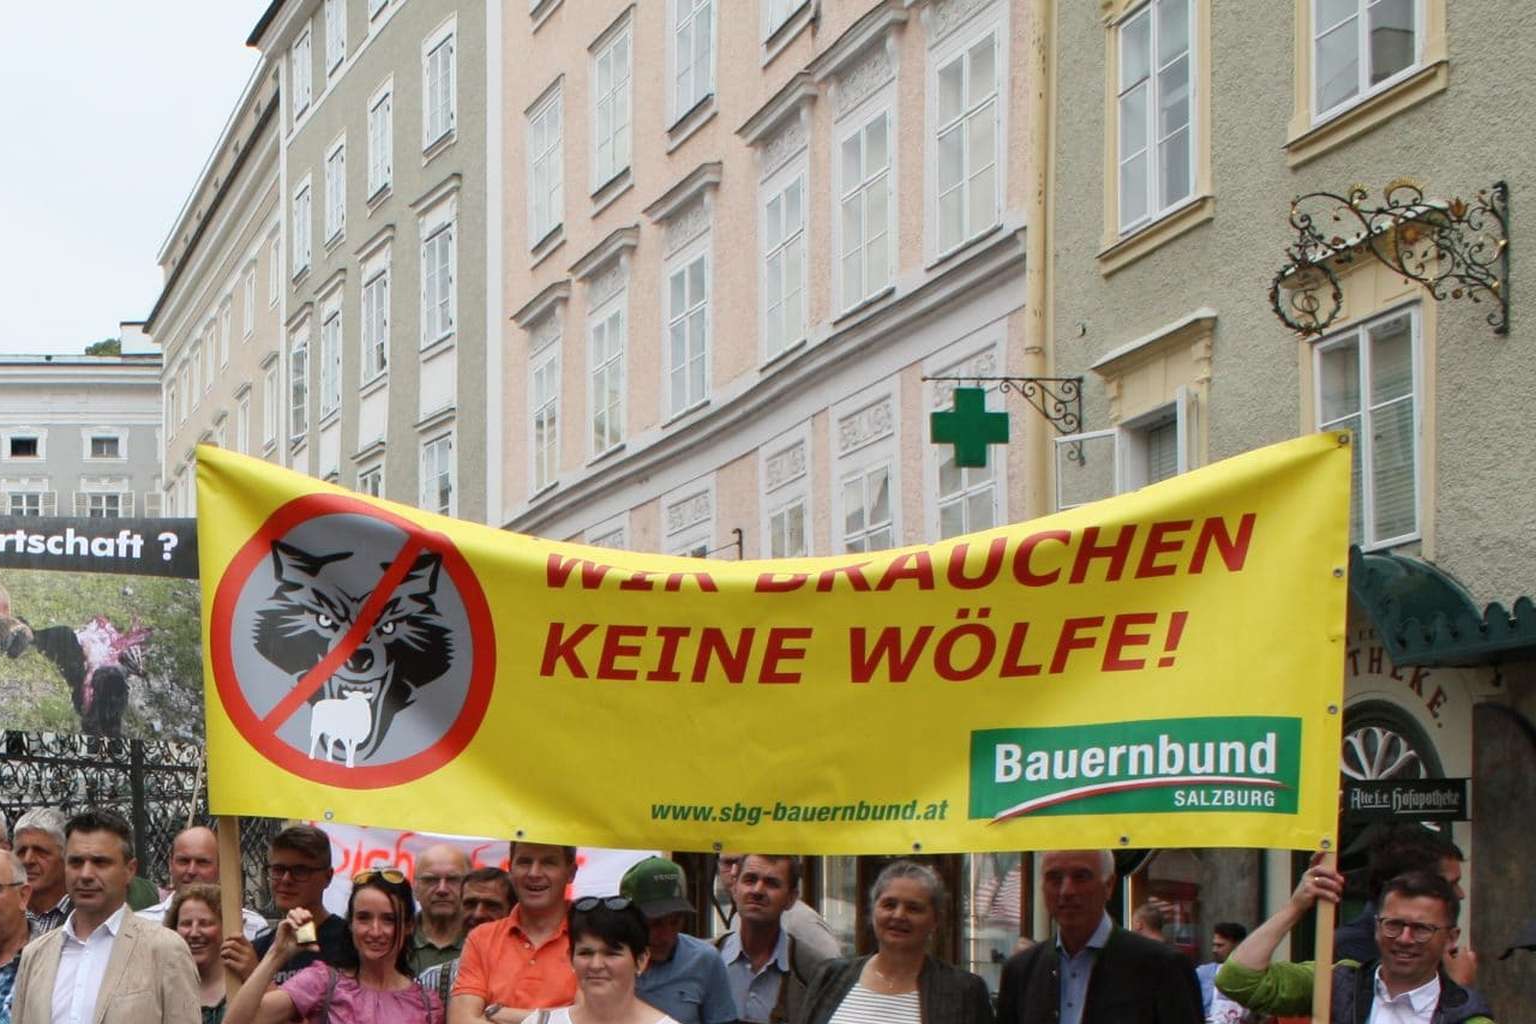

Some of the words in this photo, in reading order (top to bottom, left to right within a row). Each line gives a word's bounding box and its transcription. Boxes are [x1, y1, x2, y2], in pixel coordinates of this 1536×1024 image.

[158, 532, 178, 561] ?
[539, 622, 813, 684] KEINE
[848, 607, 1189, 684] WÖLFE!
[994, 733, 1277, 783] Bauernbund
[650, 799, 948, 826] www.sbg-bauernbund.at
[1174, 790, 1276, 808] SALZBURG
